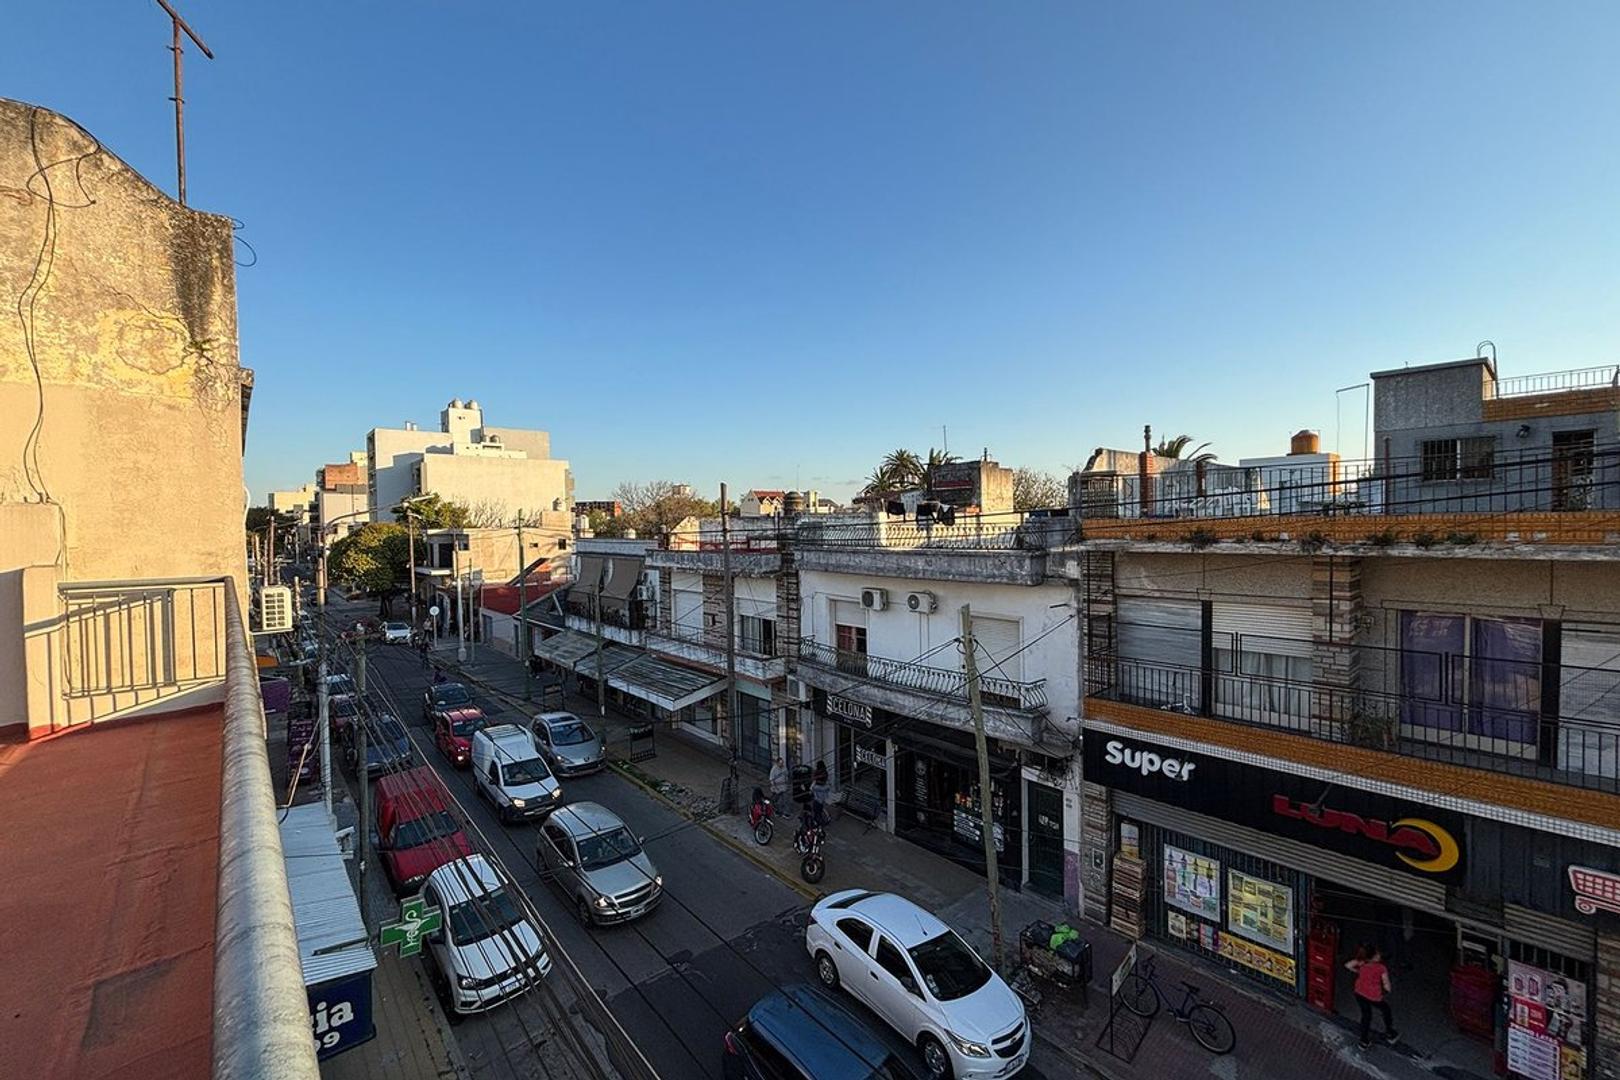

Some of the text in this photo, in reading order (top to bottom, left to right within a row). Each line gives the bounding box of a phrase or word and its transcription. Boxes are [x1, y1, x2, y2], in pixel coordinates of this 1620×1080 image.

[1104, 739, 1198, 783] Super
[1271, 792, 1442, 859] LUNA
[311, 1001, 354, 1035] ia
